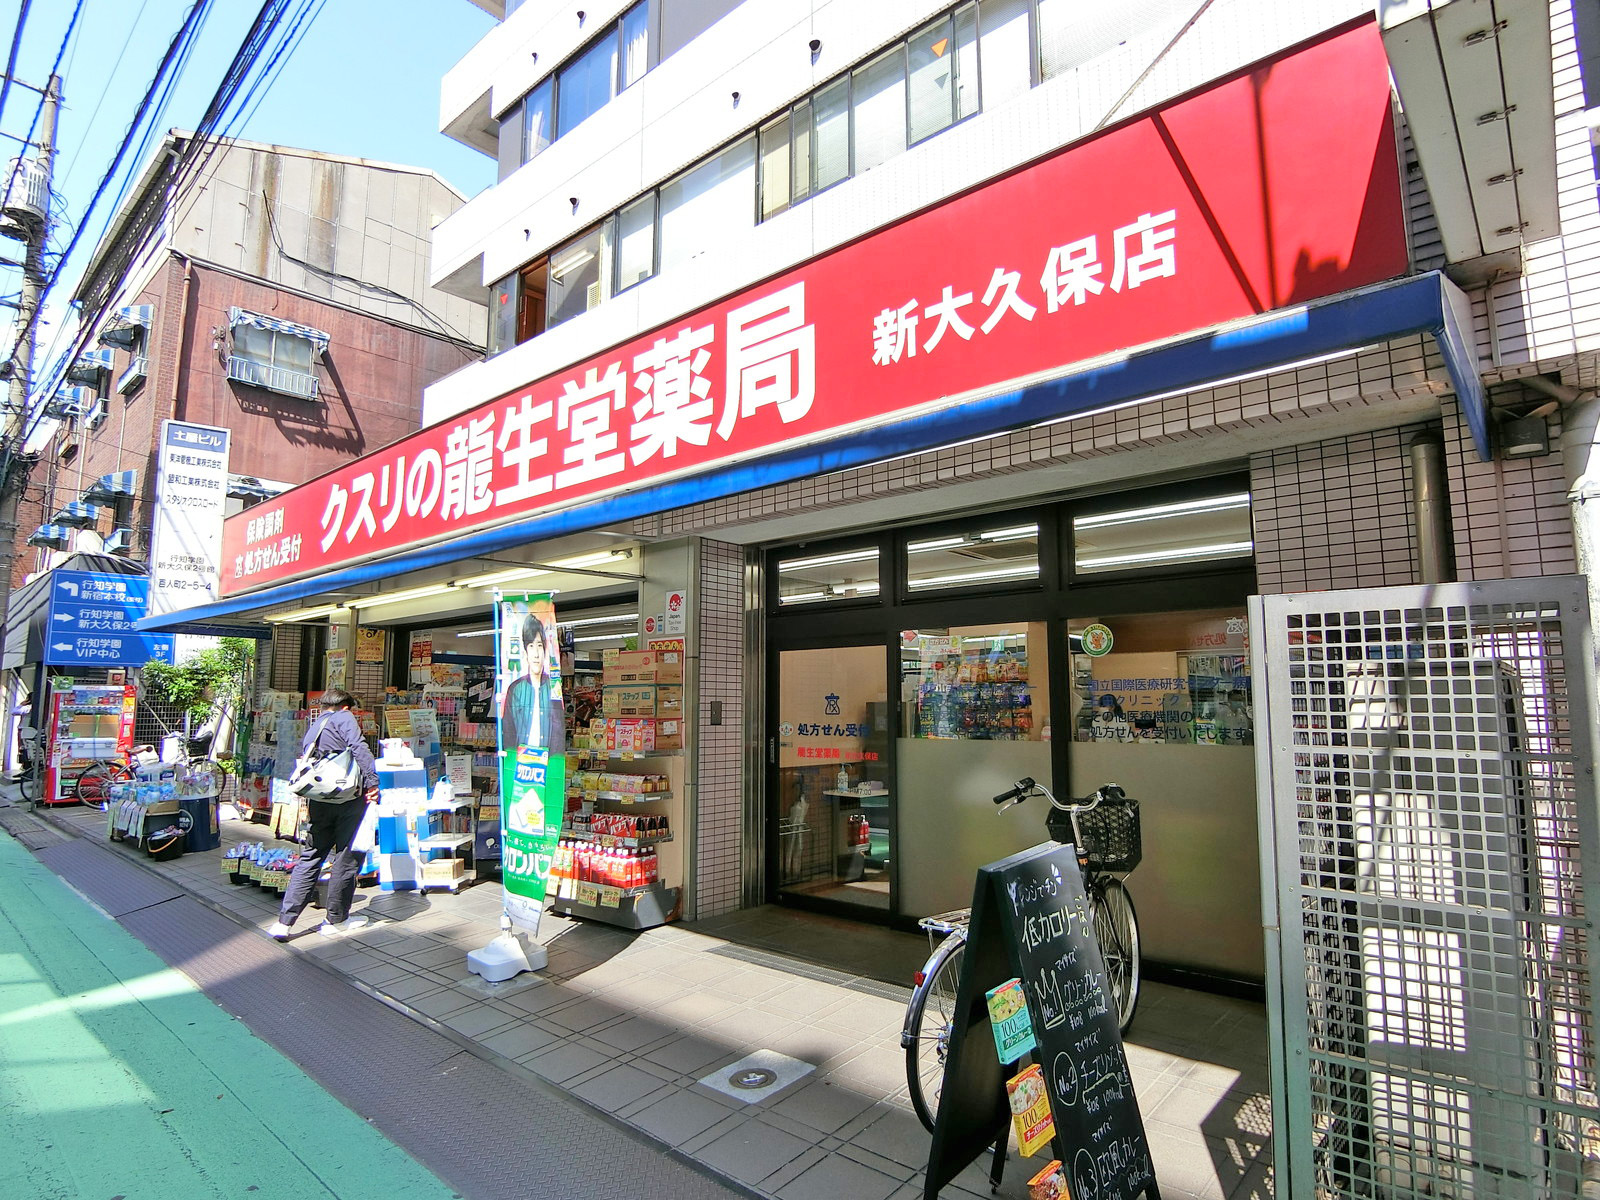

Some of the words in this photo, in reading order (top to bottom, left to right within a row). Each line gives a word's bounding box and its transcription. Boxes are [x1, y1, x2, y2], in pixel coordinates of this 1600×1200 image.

[871, 208, 1176, 367] 新大久保店
[319, 281, 816, 554] クスリの龍生堂薬局
[246, 507, 285, 546] 保険調剤
[157, 562, 215, 573] 新大久保2号館
[170, 554, 205, 565] 行知学園
[82, 579, 127, 592] 行知学園
[79, 608, 125, 620] 行知学園
[76, 637, 122, 649] 行知学園
[76, 649, 121, 659] VIP中心
[1054, 945, 1078, 971] マイサイズ
[1001, 1018, 1017, 1039] 100
[1074, 1028, 1101, 1053] マイサイズ
[1058, 1066, 1078, 1096] No.2
[1022, 1108, 1037, 1130] 100
[1091, 1115, 1113, 1143] マイサイズ
